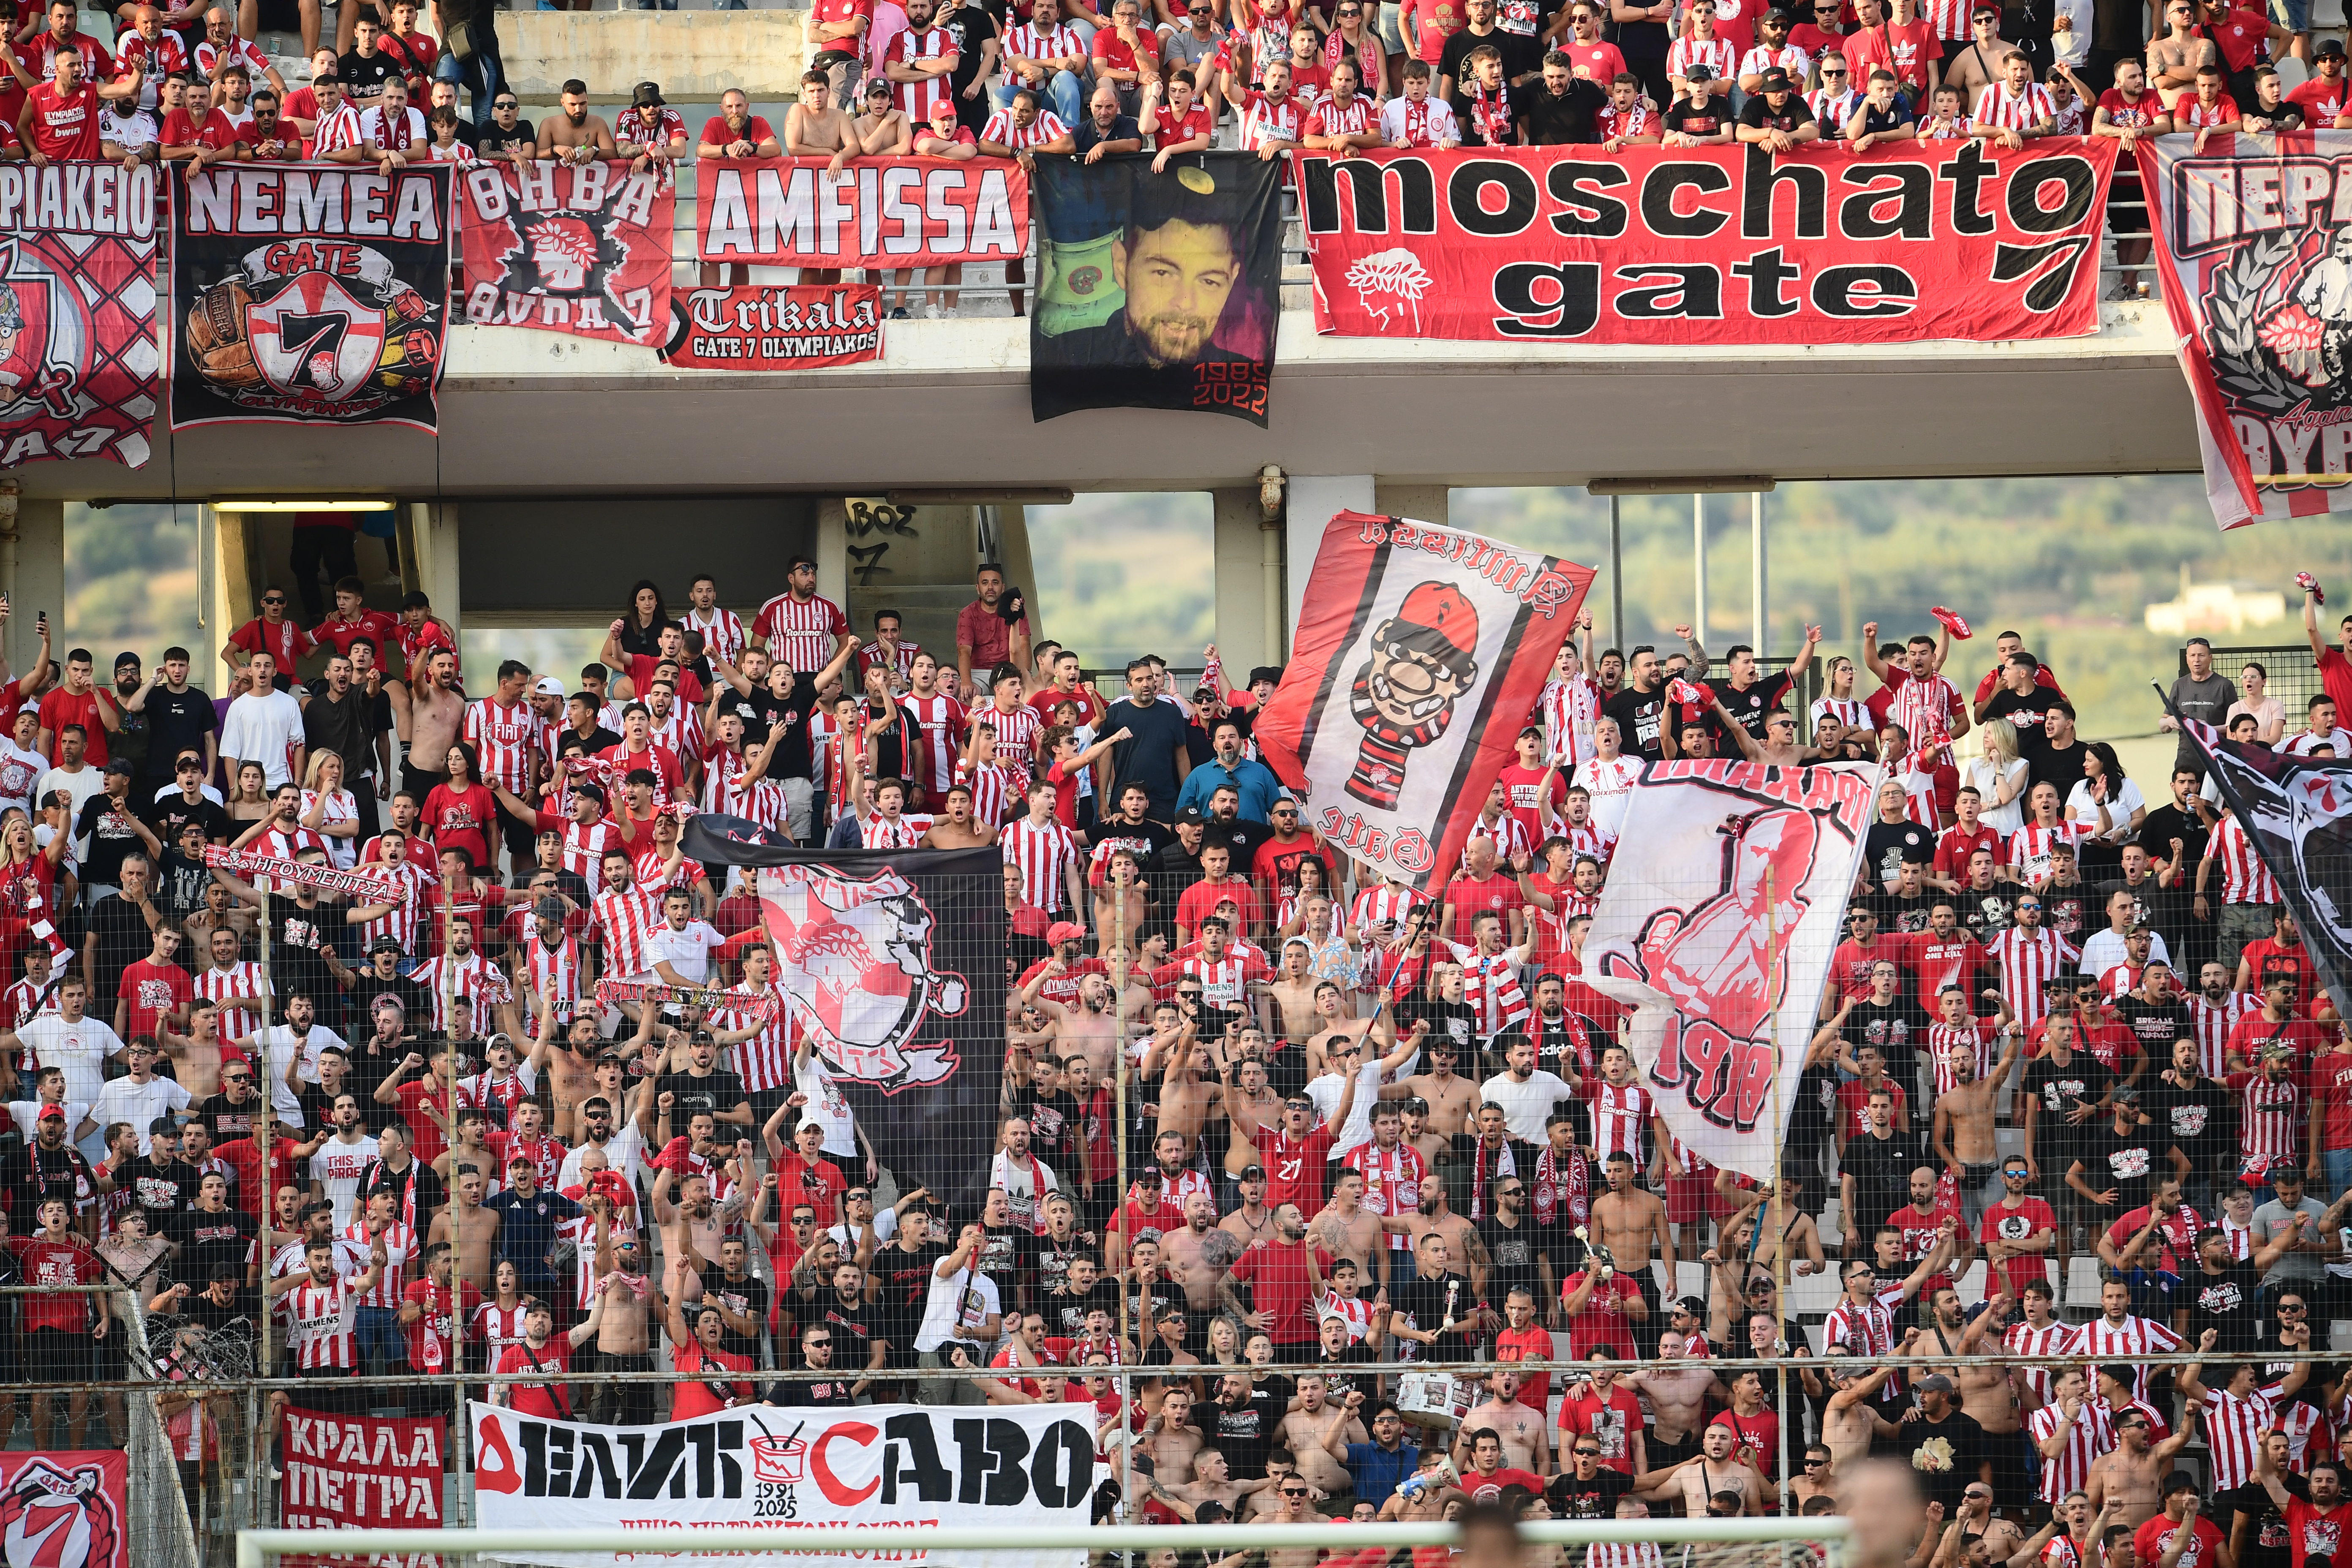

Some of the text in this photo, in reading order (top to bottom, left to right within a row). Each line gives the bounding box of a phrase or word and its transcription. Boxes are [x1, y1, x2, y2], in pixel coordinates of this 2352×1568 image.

[44, 106, 84, 120] OLYMPIACOS
[55, 127, 81, 137] bwin
[1257, 121, 1293, 136] SIEMENS
[466, 161, 653, 229] ΘΗΒΑ
[1303, 140, 2097, 240] moschato
[187, 170, 441, 242] NEMEA
[704, 167, 1019, 256] AMFISSA
[265, 243, 361, 274] GATE
[1492, 234, 2092, 337] gate 7
[623, 285, 654, 329] 7
[688, 287, 877, 333] Trikala
[278, 311, 351, 391] 7
[693, 331, 877, 359] GATE 7 OLYMPIAKOS
[240, 395, 385, 415] OLYMPIAKOS
[1193, 383, 1267, 416] 2022
[785, 628, 822, 637] Stoiximan
[494, 723, 519, 740] FIAT
[919, 721, 946, 729] iximan
[1589, 788, 1628, 798] Stoiximan
[564, 841, 602, 859] Stoiximan
[254, 855, 388, 898] ΗΓΟΥΜΕΝΙΤΣΑ
[1944, 950, 1962, 959] KILL
[1203, 983, 1233, 992] EMENS
[1208, 992, 1234, 1001] mobile
[1599, 1103, 1639, 1119] Stoiximan
[326, 1155, 353, 1167] THIS
[1277, 1158, 1301, 1180] 27
[1161, 1195, 1186, 1211] FIAT
[38, 1262, 56, 1275] WE
[1043, 1279, 1055, 1287] 1925
[299, 1316, 339, 1329] SIEMENS
[312, 1327, 338, 1337] mobile
[489, 1335, 526, 1346] Stoixima
[39, 1473, 78, 1496] GATE
[286, 1461, 438, 1520] ПЕТРА
[754, 1483, 794, 1500] 1991
[754, 1500, 797, 1518] 2025
